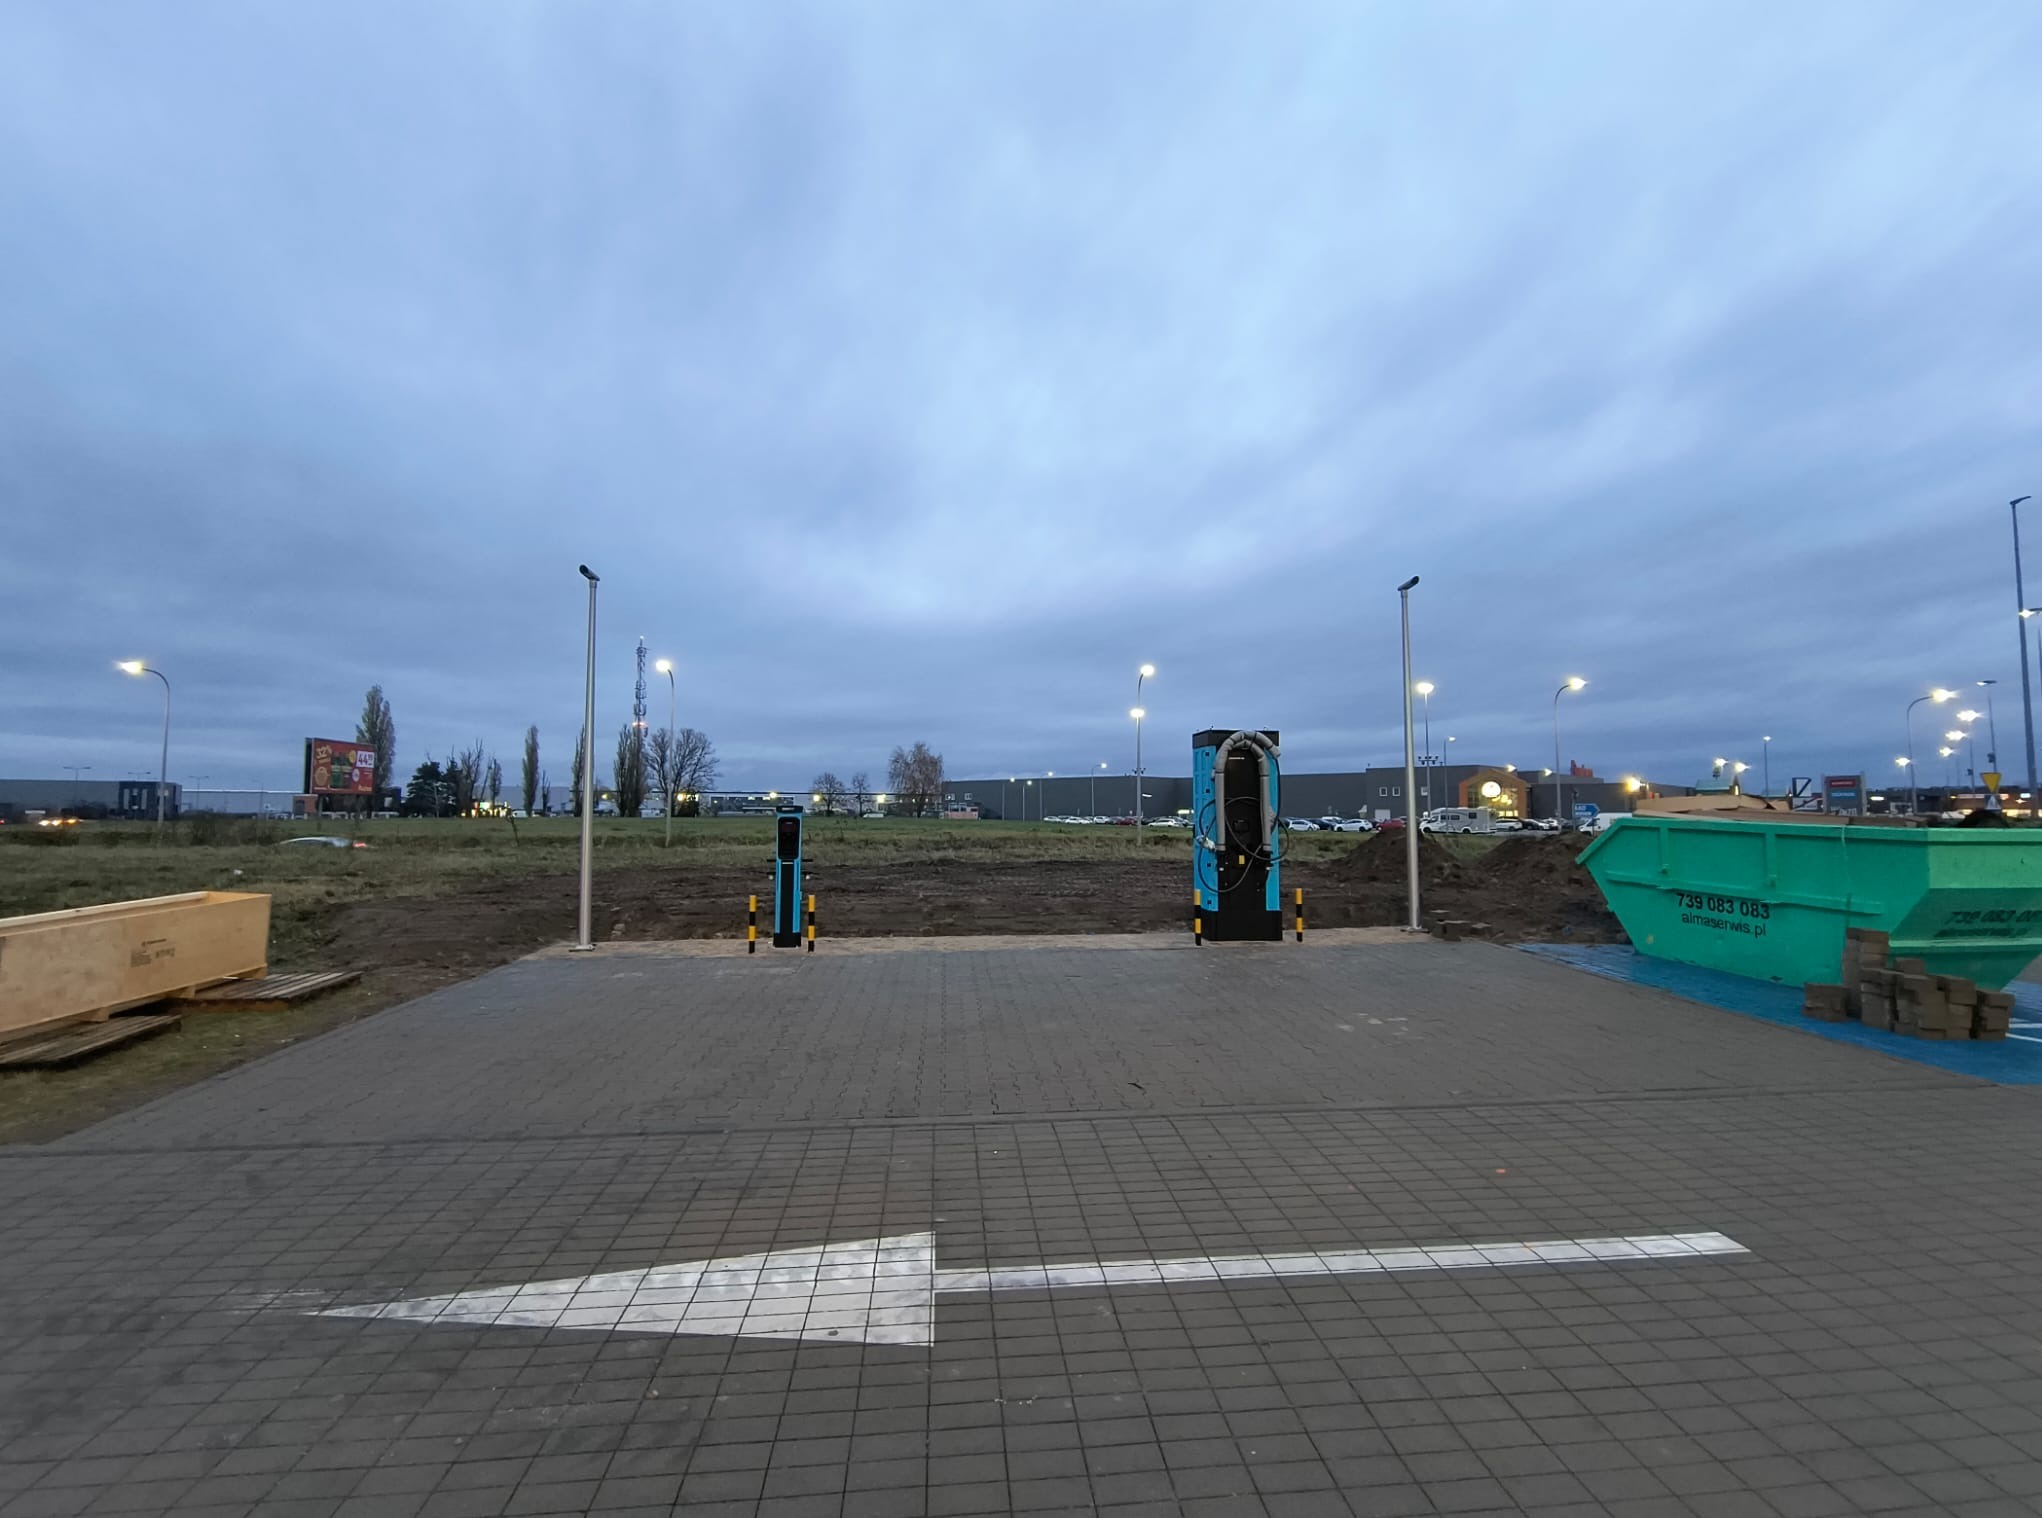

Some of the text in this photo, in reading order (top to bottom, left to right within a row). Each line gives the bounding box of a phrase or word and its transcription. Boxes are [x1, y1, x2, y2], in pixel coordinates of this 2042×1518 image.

[1676, 891, 1770, 920] 739 083 083
[1681, 912, 1766, 938] almaserwis.pl
